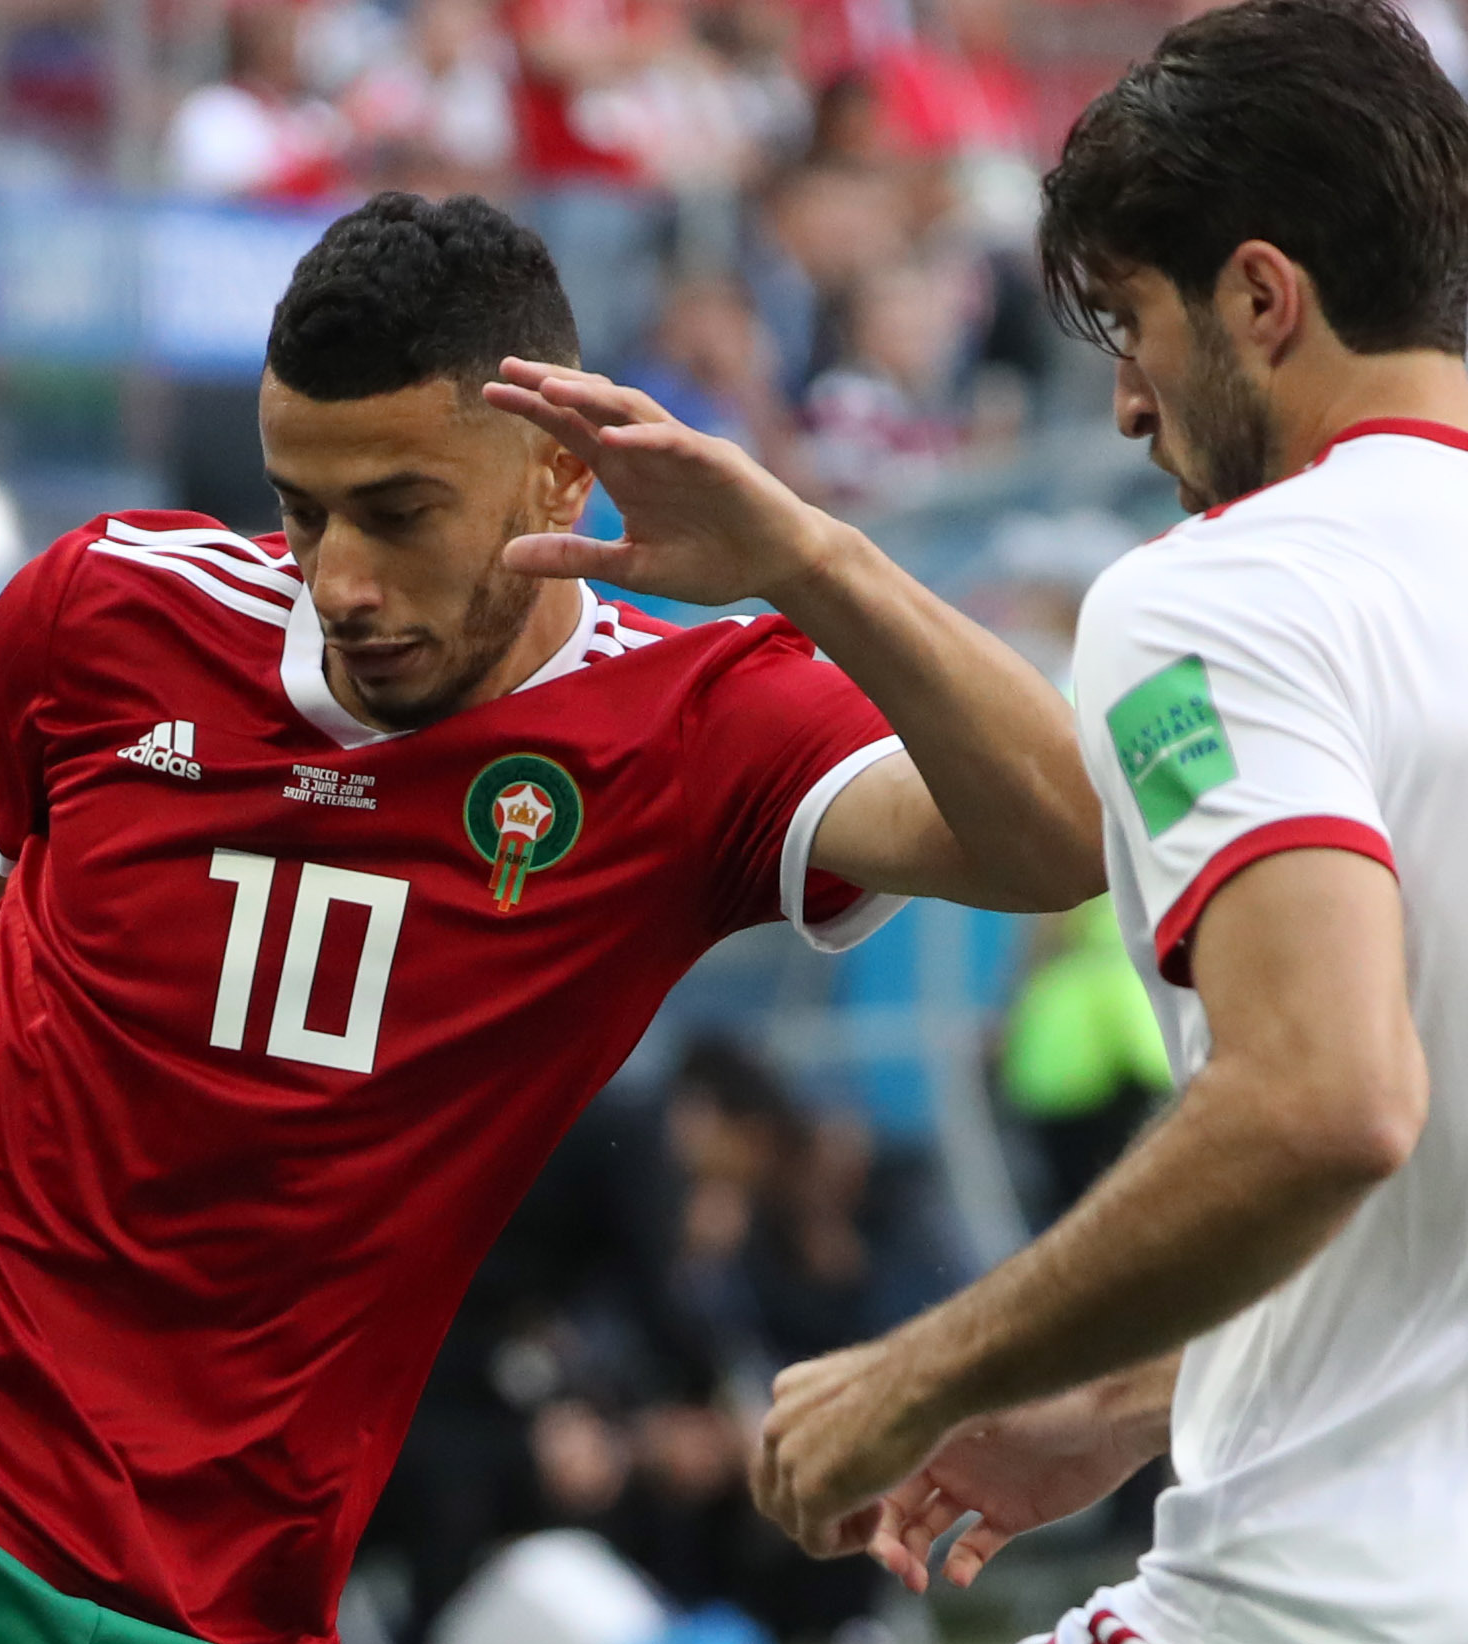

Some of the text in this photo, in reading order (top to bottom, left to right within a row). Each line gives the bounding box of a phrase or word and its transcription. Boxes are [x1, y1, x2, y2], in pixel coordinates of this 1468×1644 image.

[292, 764, 339, 782] MOROCCO
[348, 773, 376, 787] IRAN
[300, 777, 310, 790] 15
[311, 780, 338, 795] JUNE
[282, 786, 377, 810] SAINT PETERSBURG
[209, 847, 410, 1074] 10
